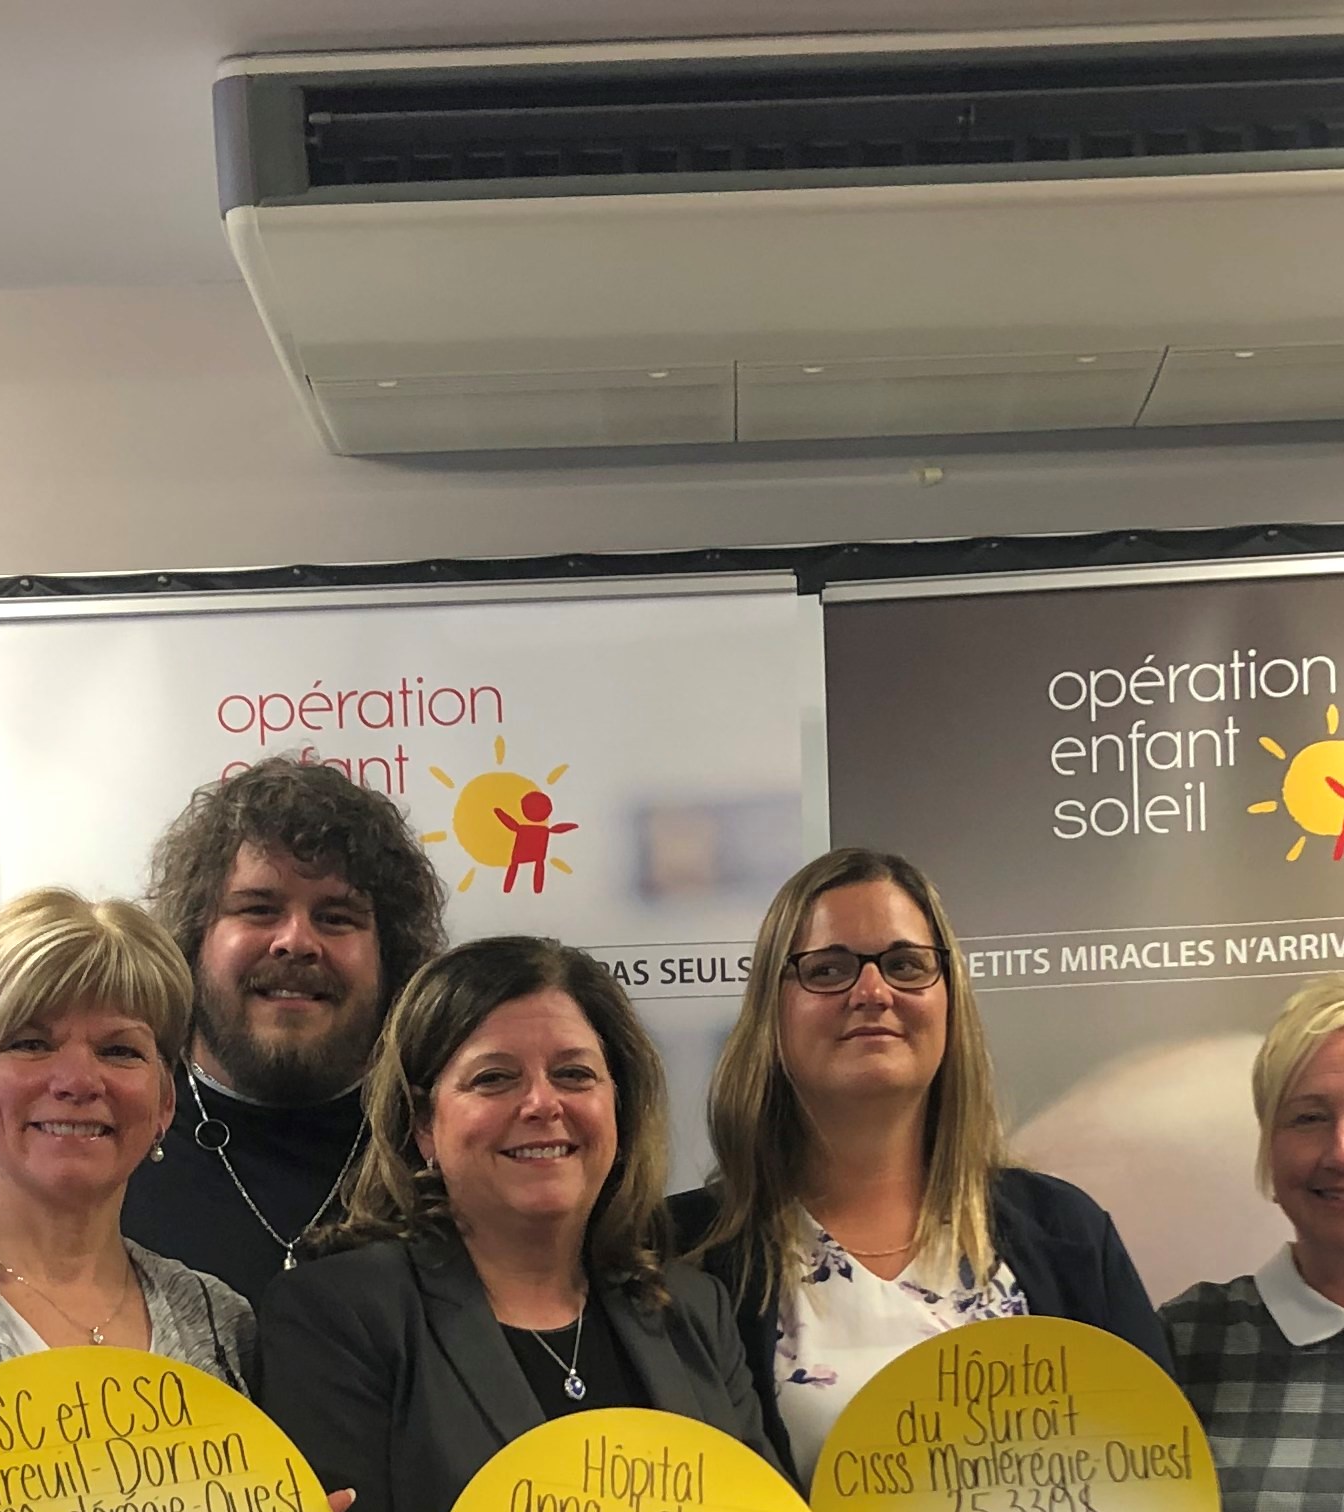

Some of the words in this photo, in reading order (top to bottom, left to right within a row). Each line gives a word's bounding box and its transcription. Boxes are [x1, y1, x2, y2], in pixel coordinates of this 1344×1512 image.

[217, 676, 504, 745] opération
[1048, 649, 1337, 723] opération
[1050, 716, 1240, 790] enfant
[1052, 780, 1207, 840] soleil
[962, 948, 1051, 978] ETITS
[1060, 940, 1215, 974] MIRACLES
[937, 1343, 1068, 1410] Hôpital
[56, 1382, 90, 1444] et
[896, 1401, 941, 1447] du
[964, 1395, 1079, 1446] Suroît
[582, 1435, 705, 1507] Hôpital
